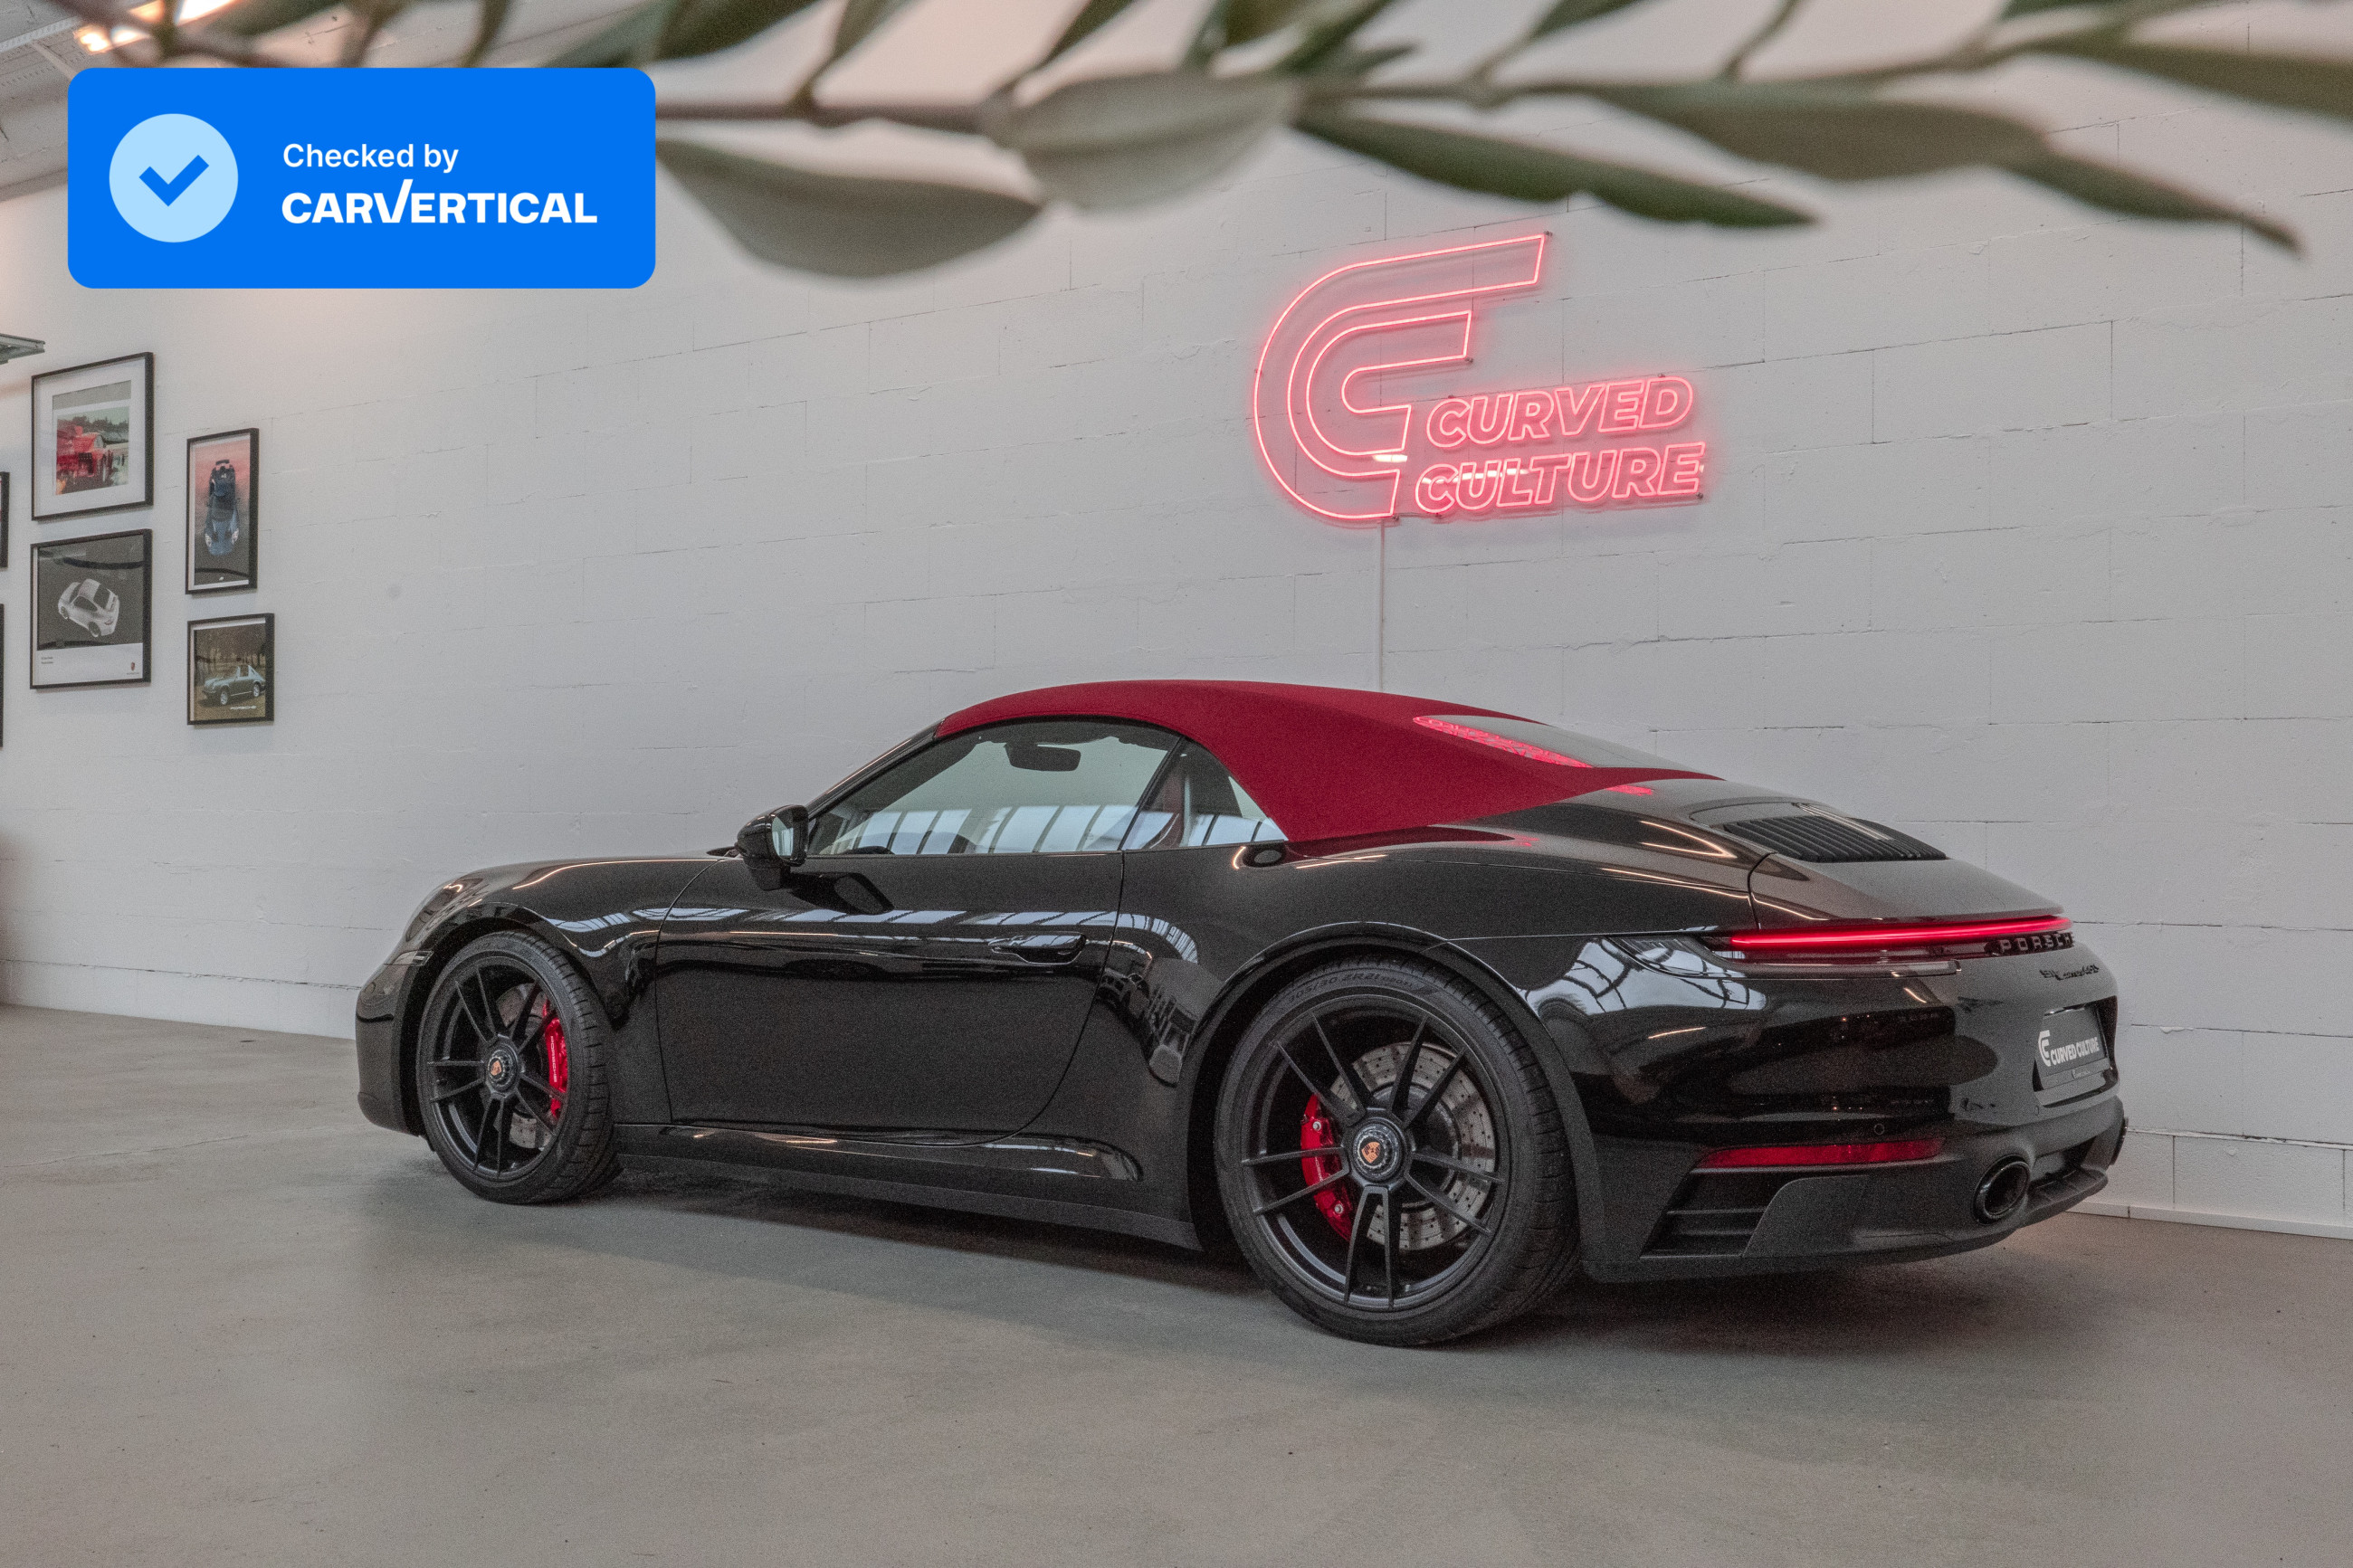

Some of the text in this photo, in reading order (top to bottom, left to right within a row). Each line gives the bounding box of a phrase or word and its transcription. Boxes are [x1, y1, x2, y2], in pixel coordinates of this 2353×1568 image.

[1425, 375, 1694, 449] CURVED
[1414, 442, 1706, 514] CULTURE
[1998, 933, 2074, 953] PORSCH
[2050, 1036, 2100, 1066] CURVED CULTURE
